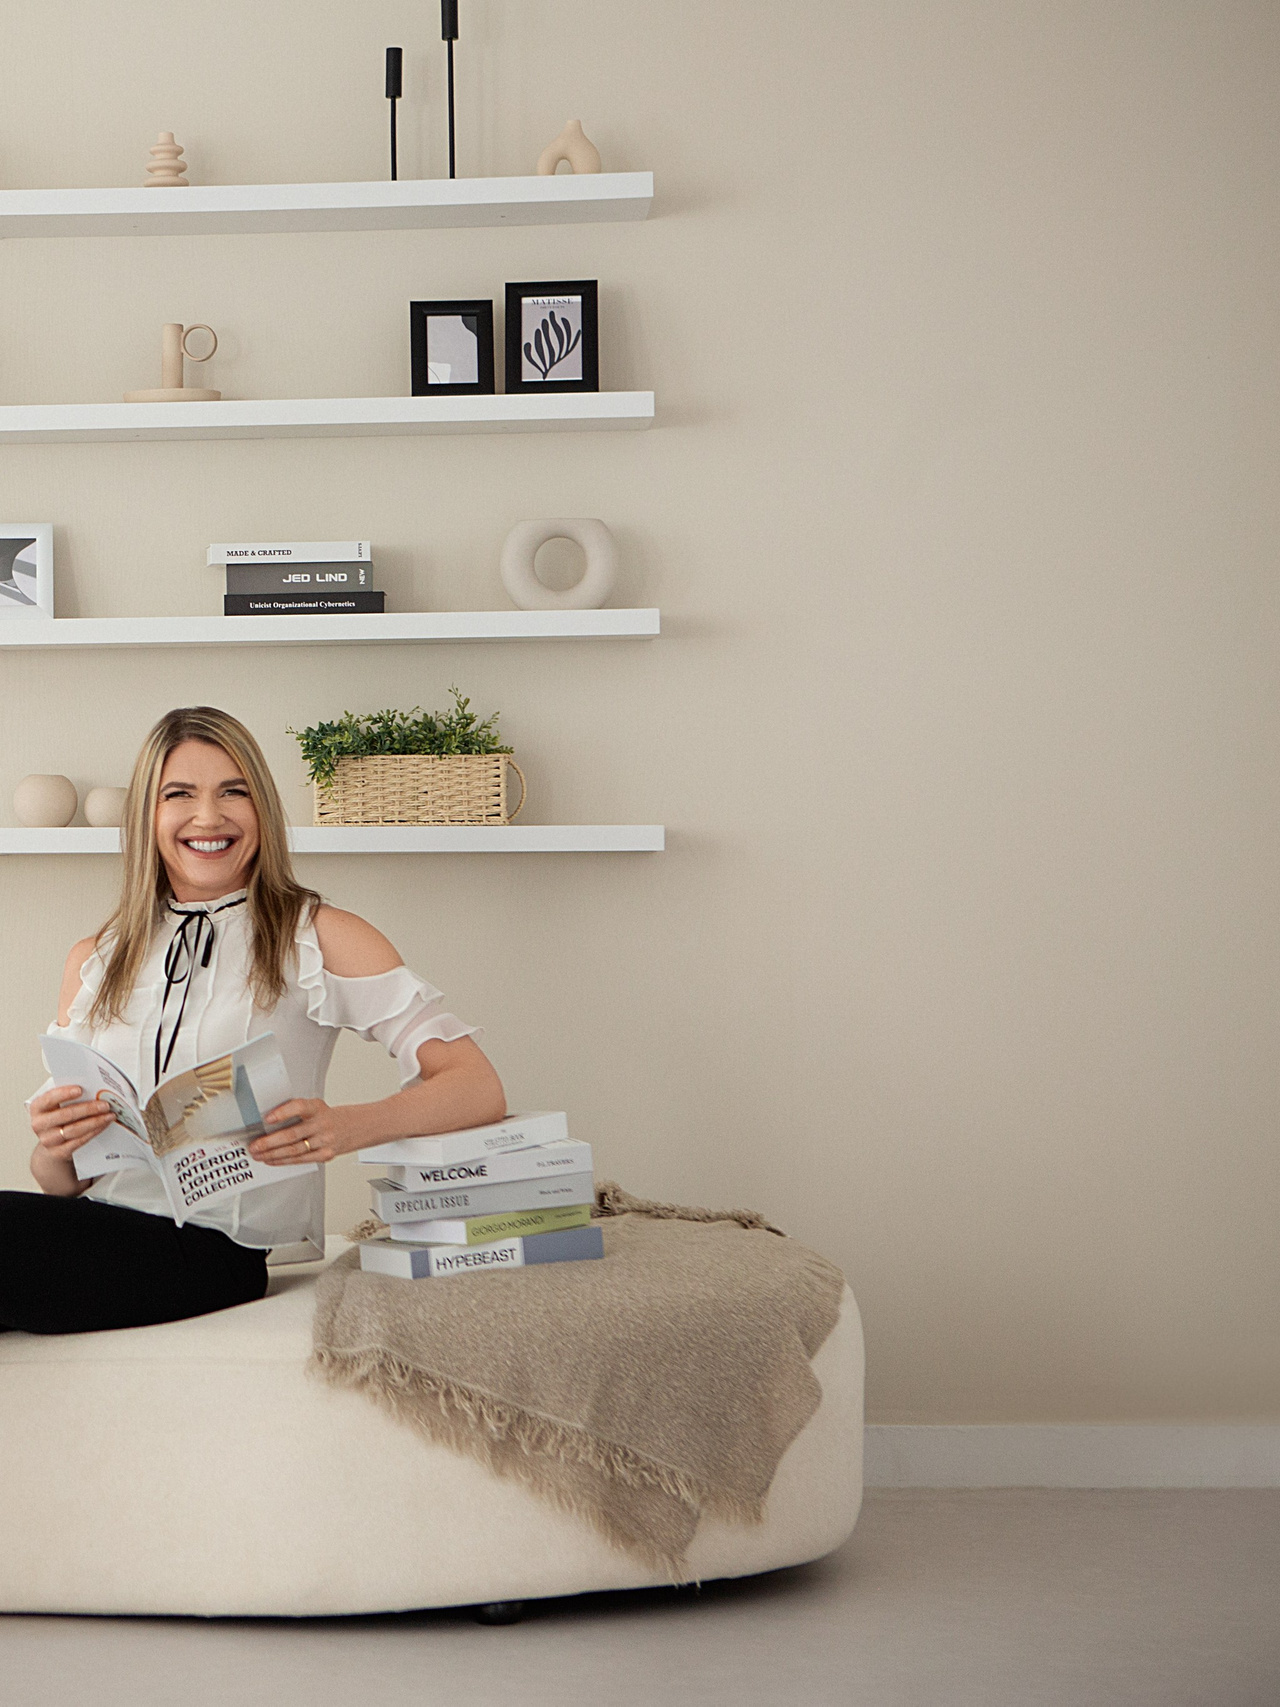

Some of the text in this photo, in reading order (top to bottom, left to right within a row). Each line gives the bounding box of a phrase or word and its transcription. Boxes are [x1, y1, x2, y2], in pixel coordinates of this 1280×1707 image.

[282, 573, 348, 583] JED LIND
[358, 568, 366, 585] NEW
[272, 601, 319, 609] Organizational
[319, 601, 356, 609] Cybernetics
[173, 1147, 207, 1173] 2023
[177, 1147, 248, 1185] INTERIOR
[181, 1158, 250, 1196] LIGHTING
[419, 1164, 489, 1183] WELCOME
[184, 1169, 255, 1207] COLLECTION
[394, 1194, 471, 1214] SPECIAL ISSUE
[435, 1247, 517, 1271] HYPEBEAST
